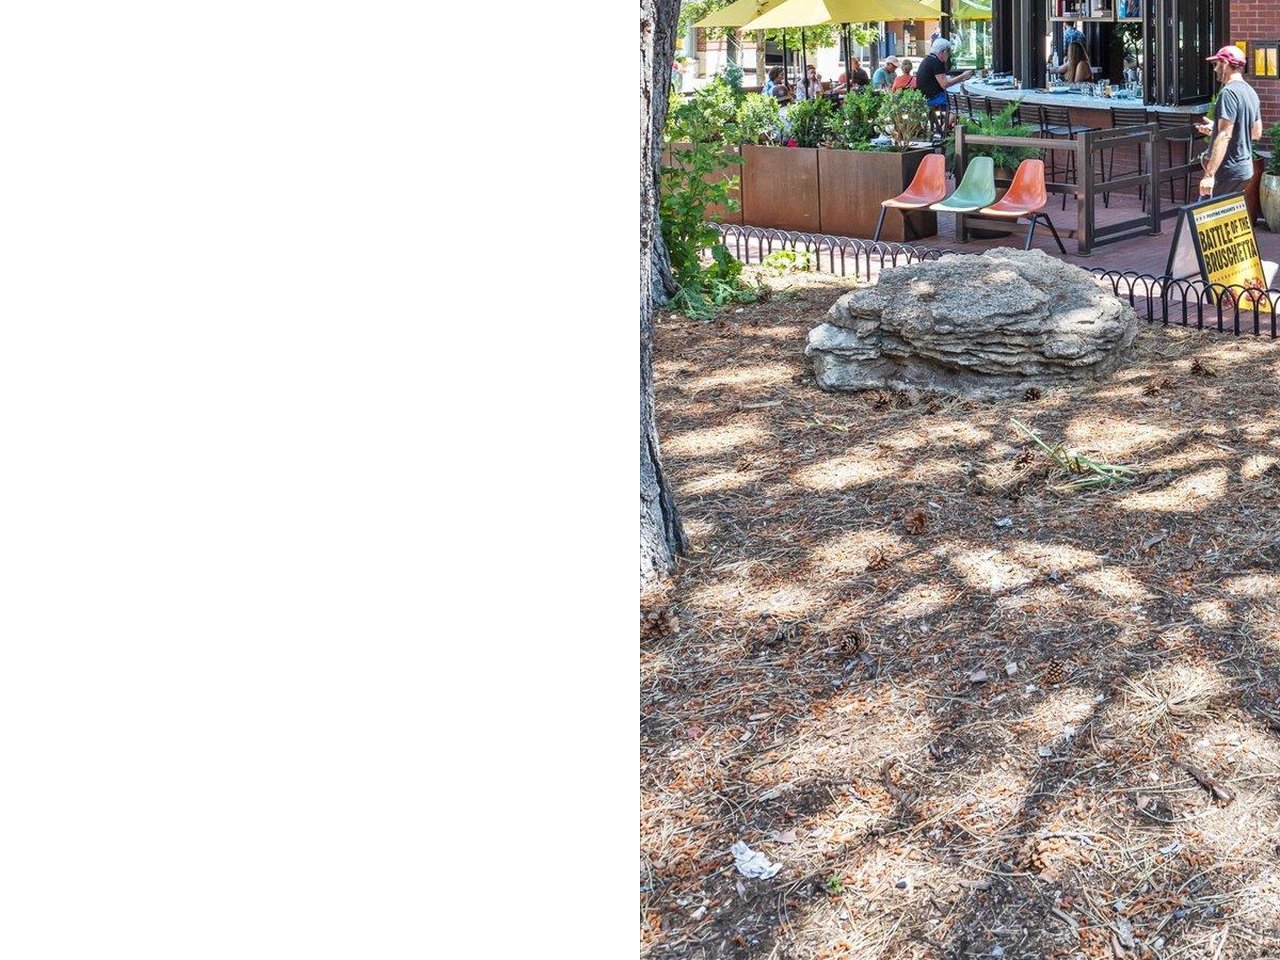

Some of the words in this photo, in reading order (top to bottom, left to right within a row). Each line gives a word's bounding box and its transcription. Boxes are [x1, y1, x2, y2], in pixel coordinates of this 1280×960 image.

[1199, 222, 1233, 252] BATTLE
[1230, 219, 1239, 234] OF
[1238, 216, 1250, 232] THE
[1203, 238, 1258, 274] BRUSCHETTA
